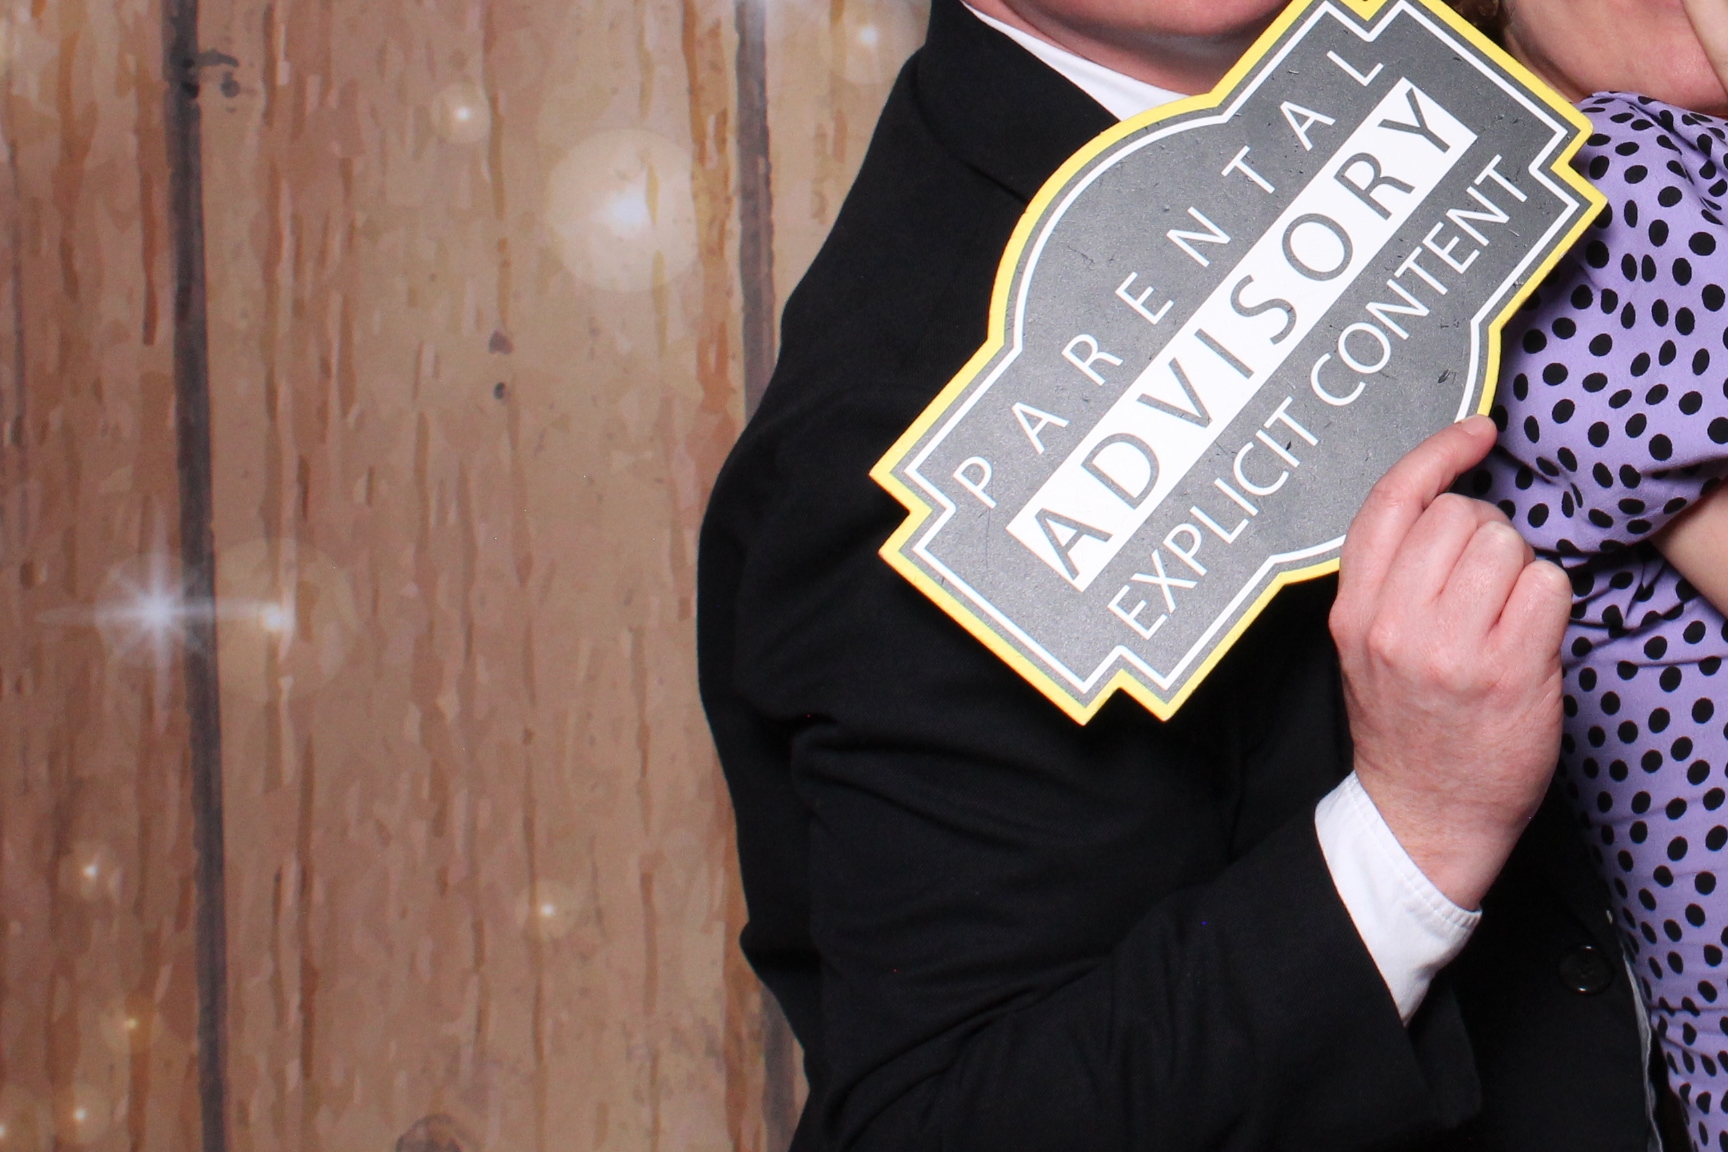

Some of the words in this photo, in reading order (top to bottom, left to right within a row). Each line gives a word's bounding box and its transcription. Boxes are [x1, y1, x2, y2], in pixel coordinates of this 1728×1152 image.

[952, 50, 1384, 509] PARENTAL
[1032, 86, 1452, 581] ADVISORY
[1107, 396, 1318, 640] EXPLICIT
[1310, 154, 1529, 407] CONTENT
